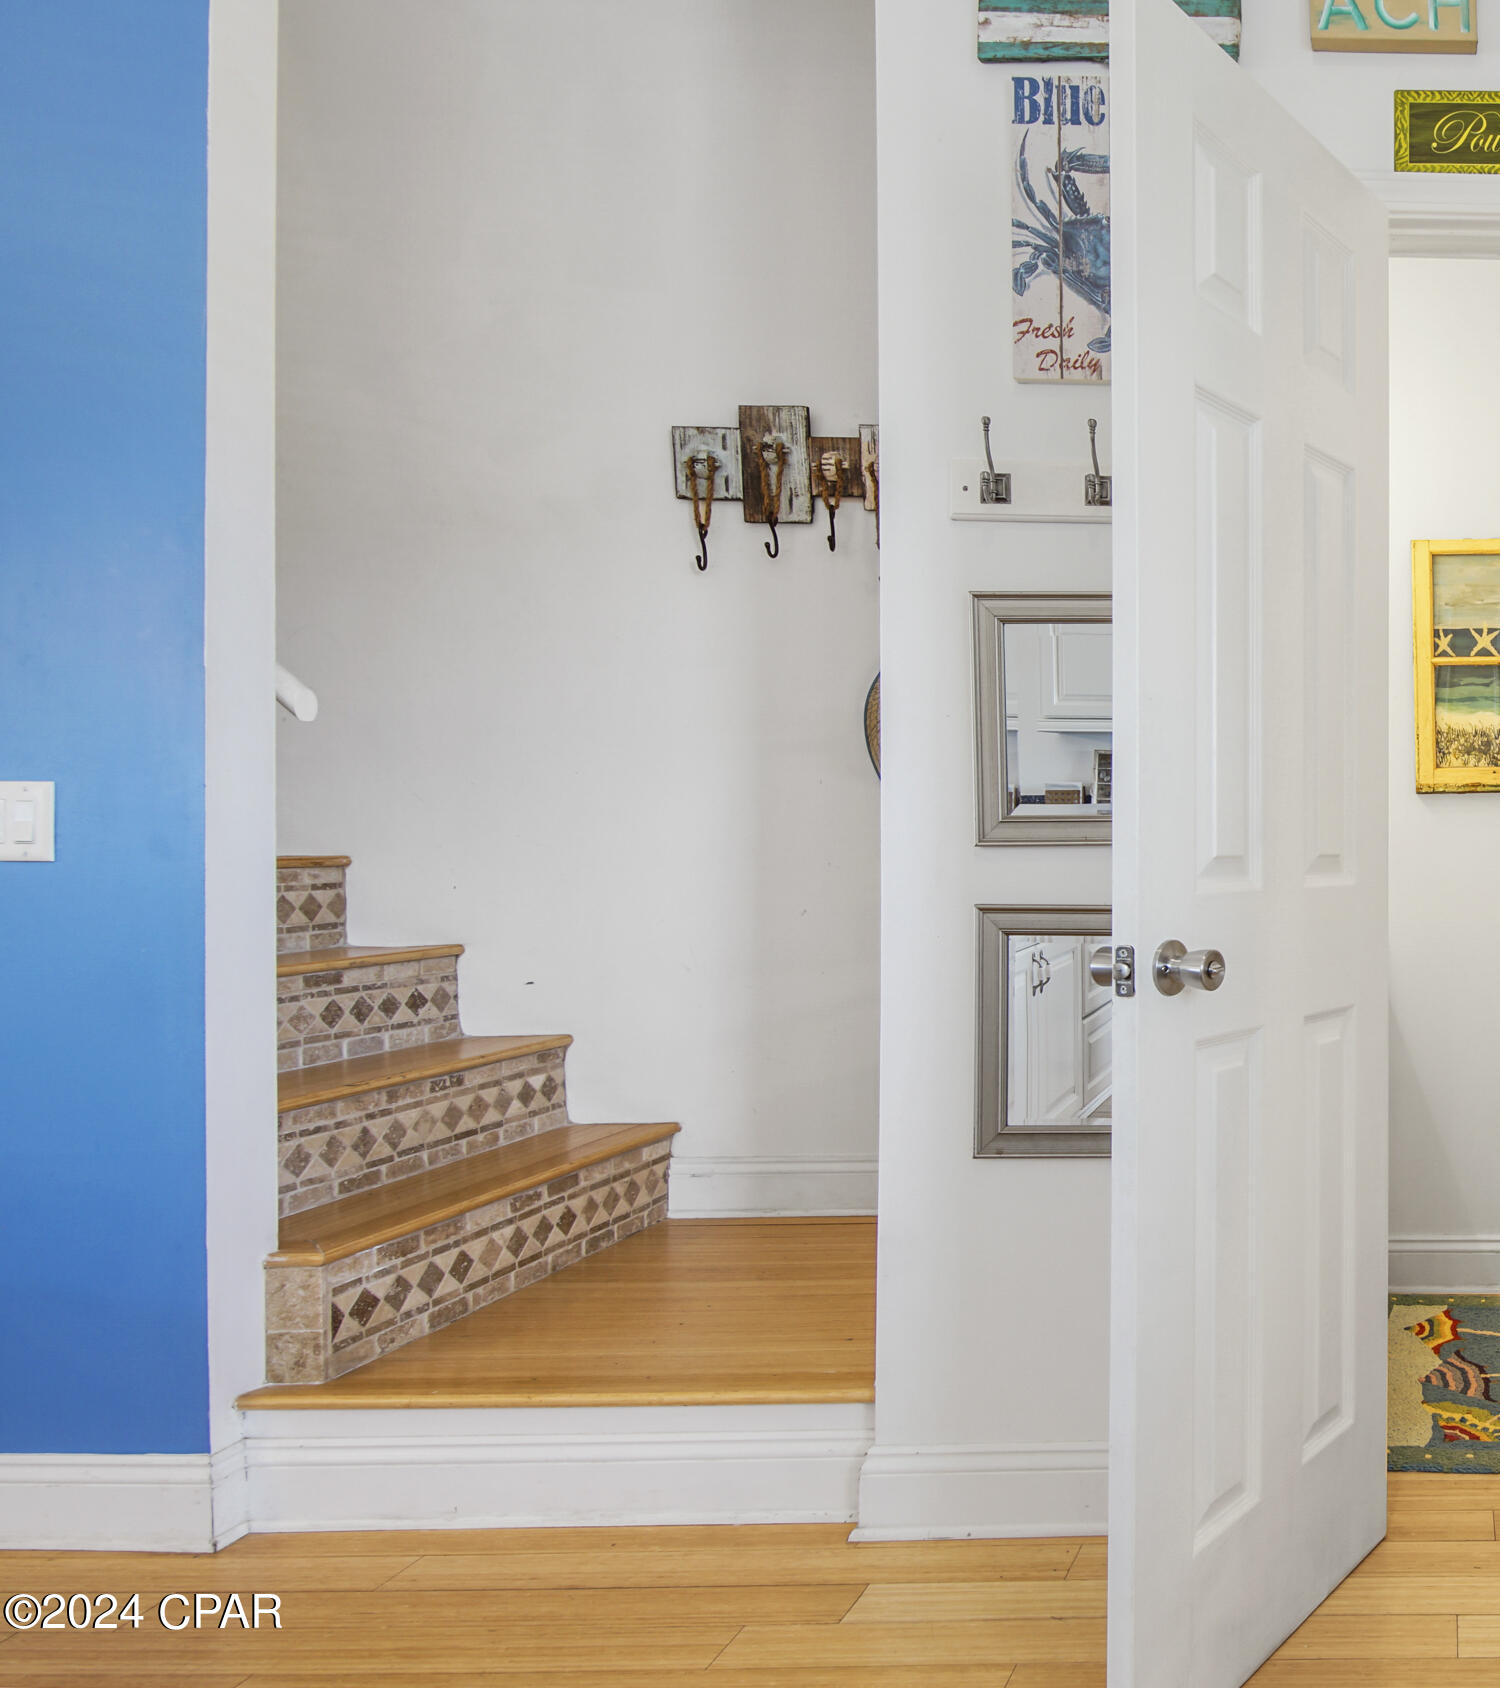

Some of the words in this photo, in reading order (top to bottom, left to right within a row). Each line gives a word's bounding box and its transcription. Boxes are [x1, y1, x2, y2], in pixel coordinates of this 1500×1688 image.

[1011, 76, 1106, 126] Blue
[1012, 316, 1075, 344] Fresh
[1036, 348, 1101, 377] Daily
